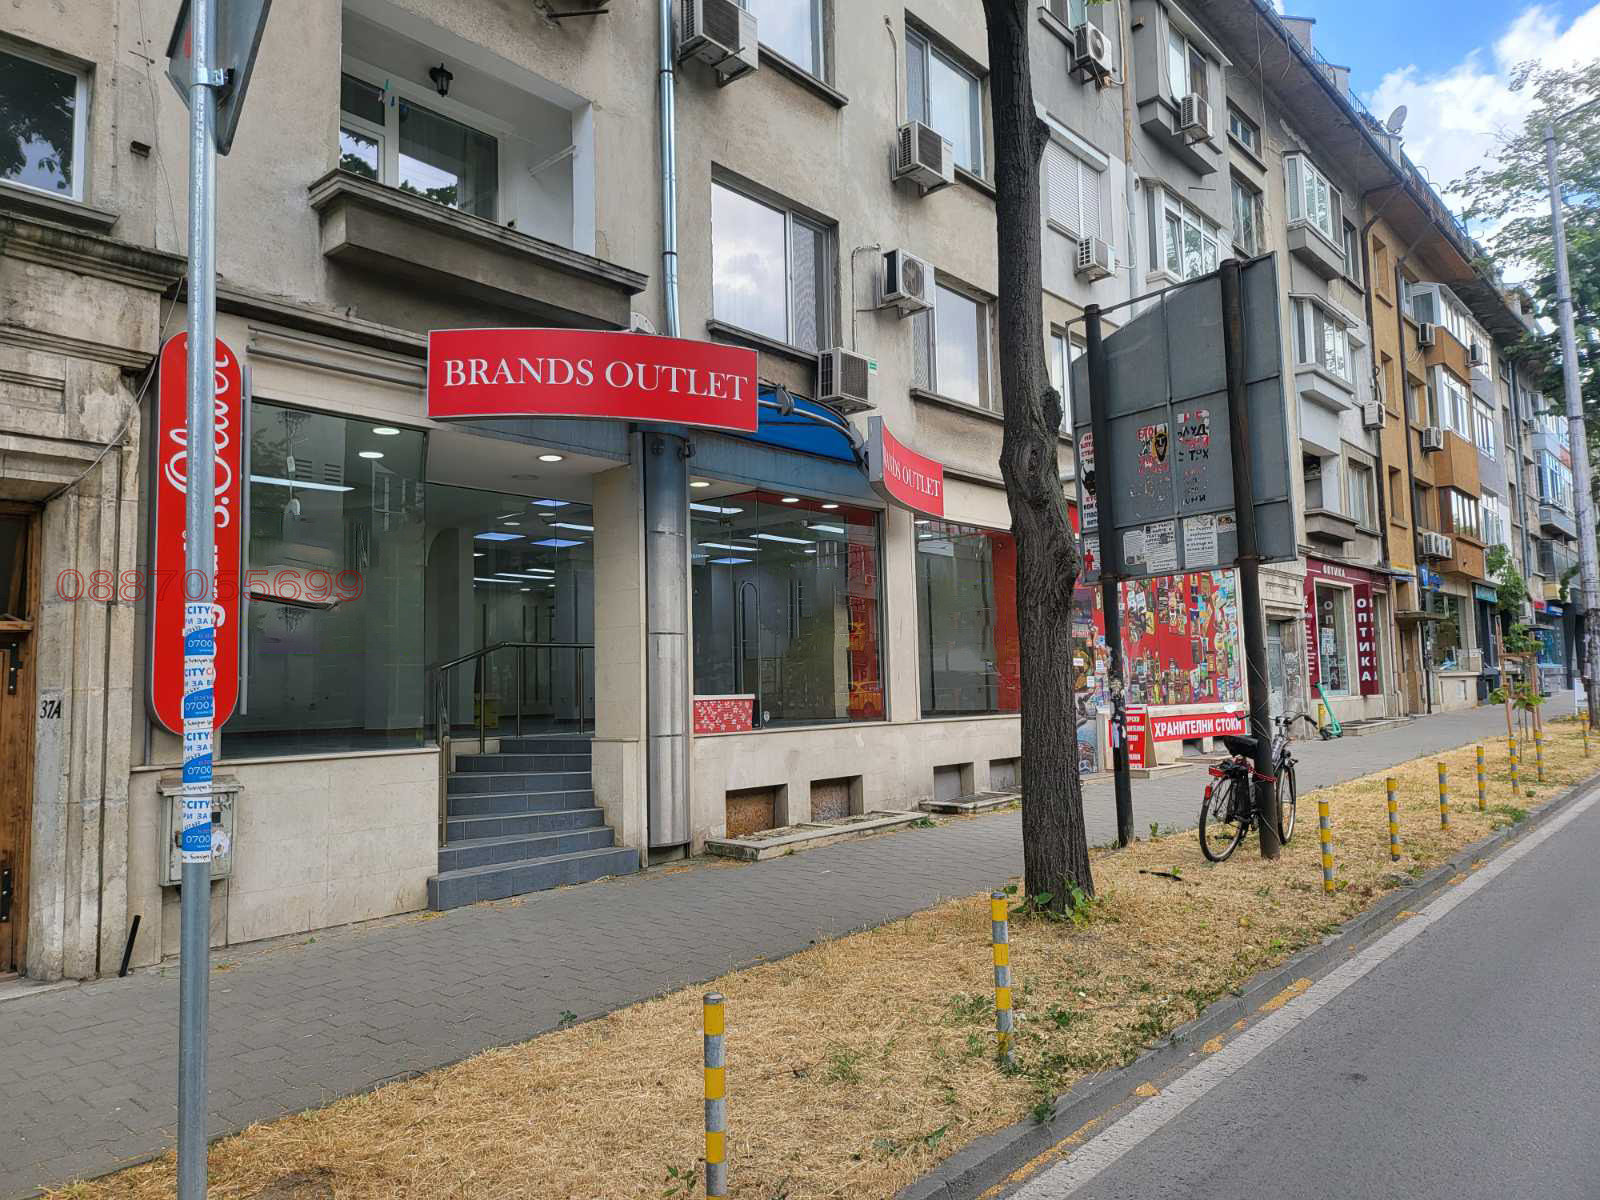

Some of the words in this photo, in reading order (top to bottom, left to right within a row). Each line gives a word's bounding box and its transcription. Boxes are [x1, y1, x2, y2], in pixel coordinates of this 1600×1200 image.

[443, 357, 594, 388] BRANDS
[605, 360, 749, 401] OUTLET
[902, 465, 942, 497] OUTLET
[1356, 598, 1371, 681] ОПТИКА
[39, 700, 62, 719] 37A
[1153, 718, 1214, 738] ХРАНИТЕЛНИ
[1215, 716, 1242, 732] СТОКИ
